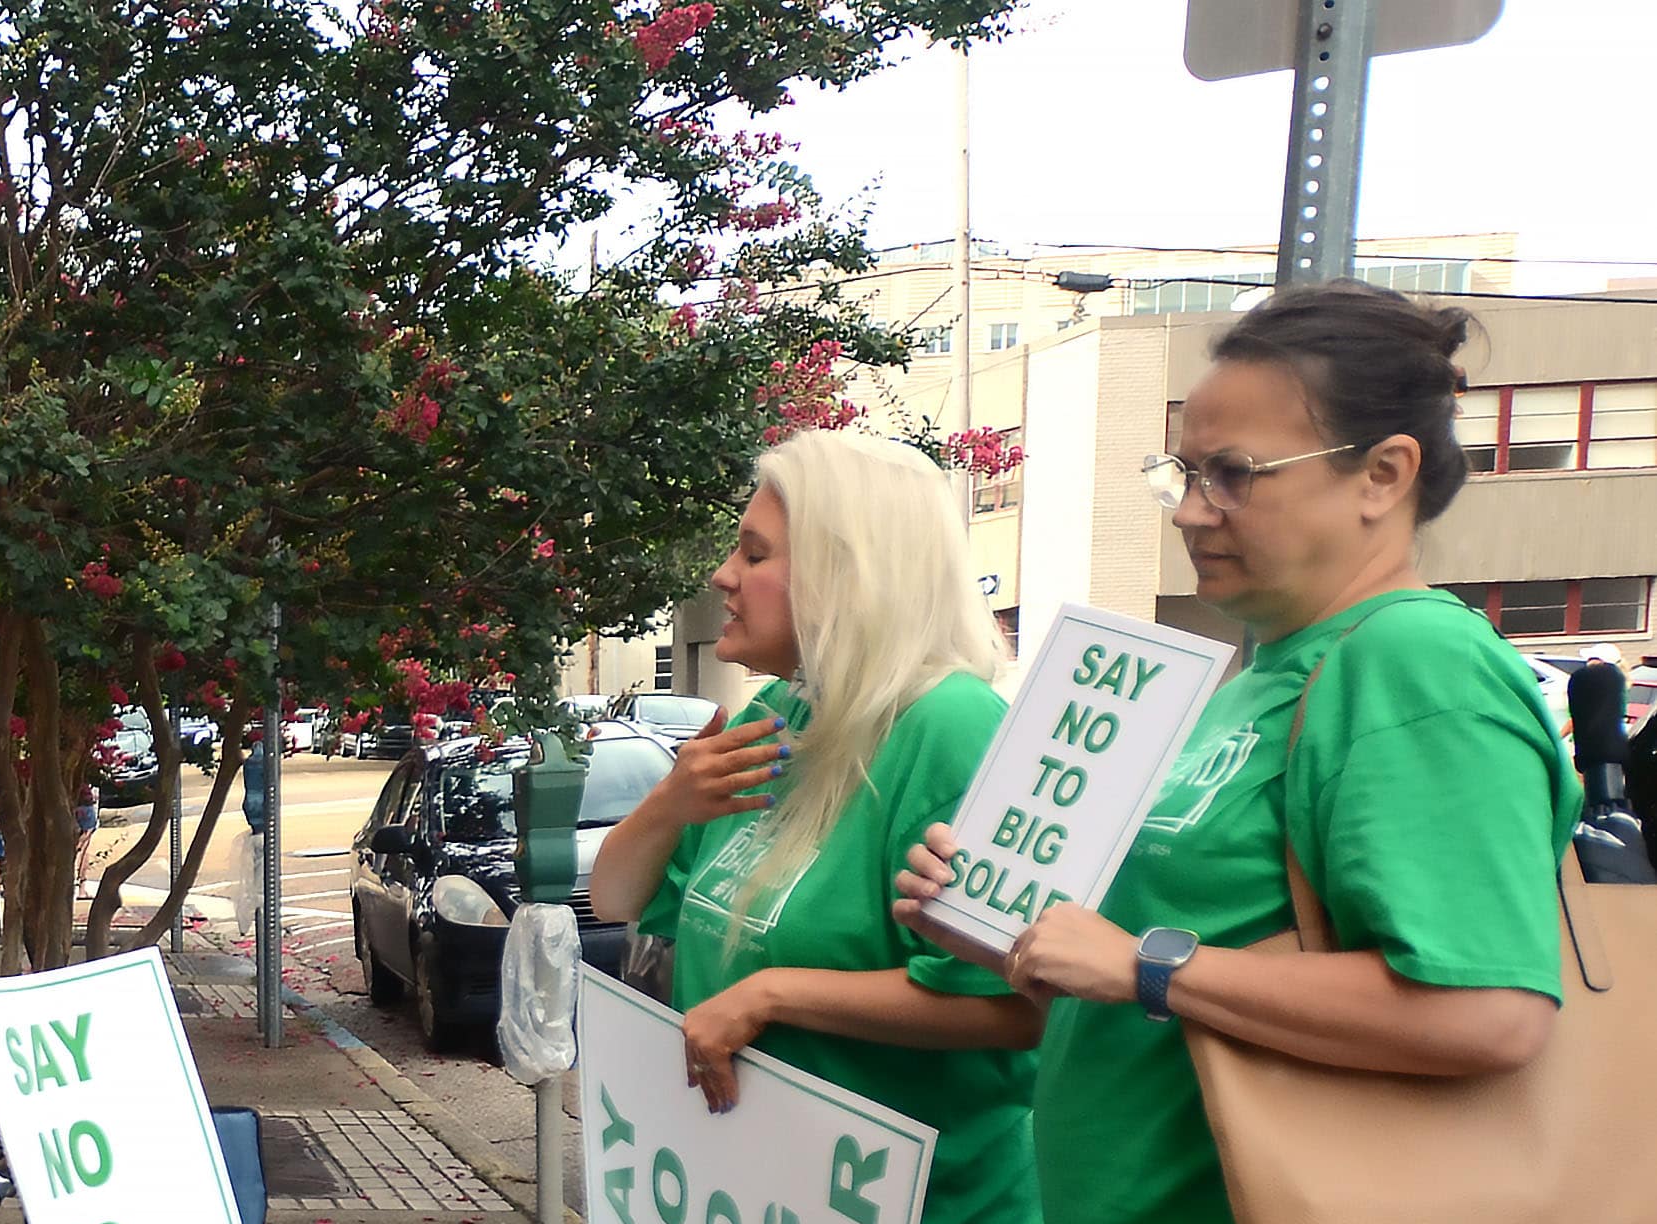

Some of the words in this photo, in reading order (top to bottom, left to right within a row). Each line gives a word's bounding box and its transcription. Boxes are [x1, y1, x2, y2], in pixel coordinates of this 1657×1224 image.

[1072, 643, 1166, 702] SAY
[1051, 701, 1120, 754] NO
[1031, 756, 1089, 808] TO
[991, 806, 1069, 867] BIG
[4, 1012, 92, 1096] SAY
[39, 1119, 114, 1199] NO
